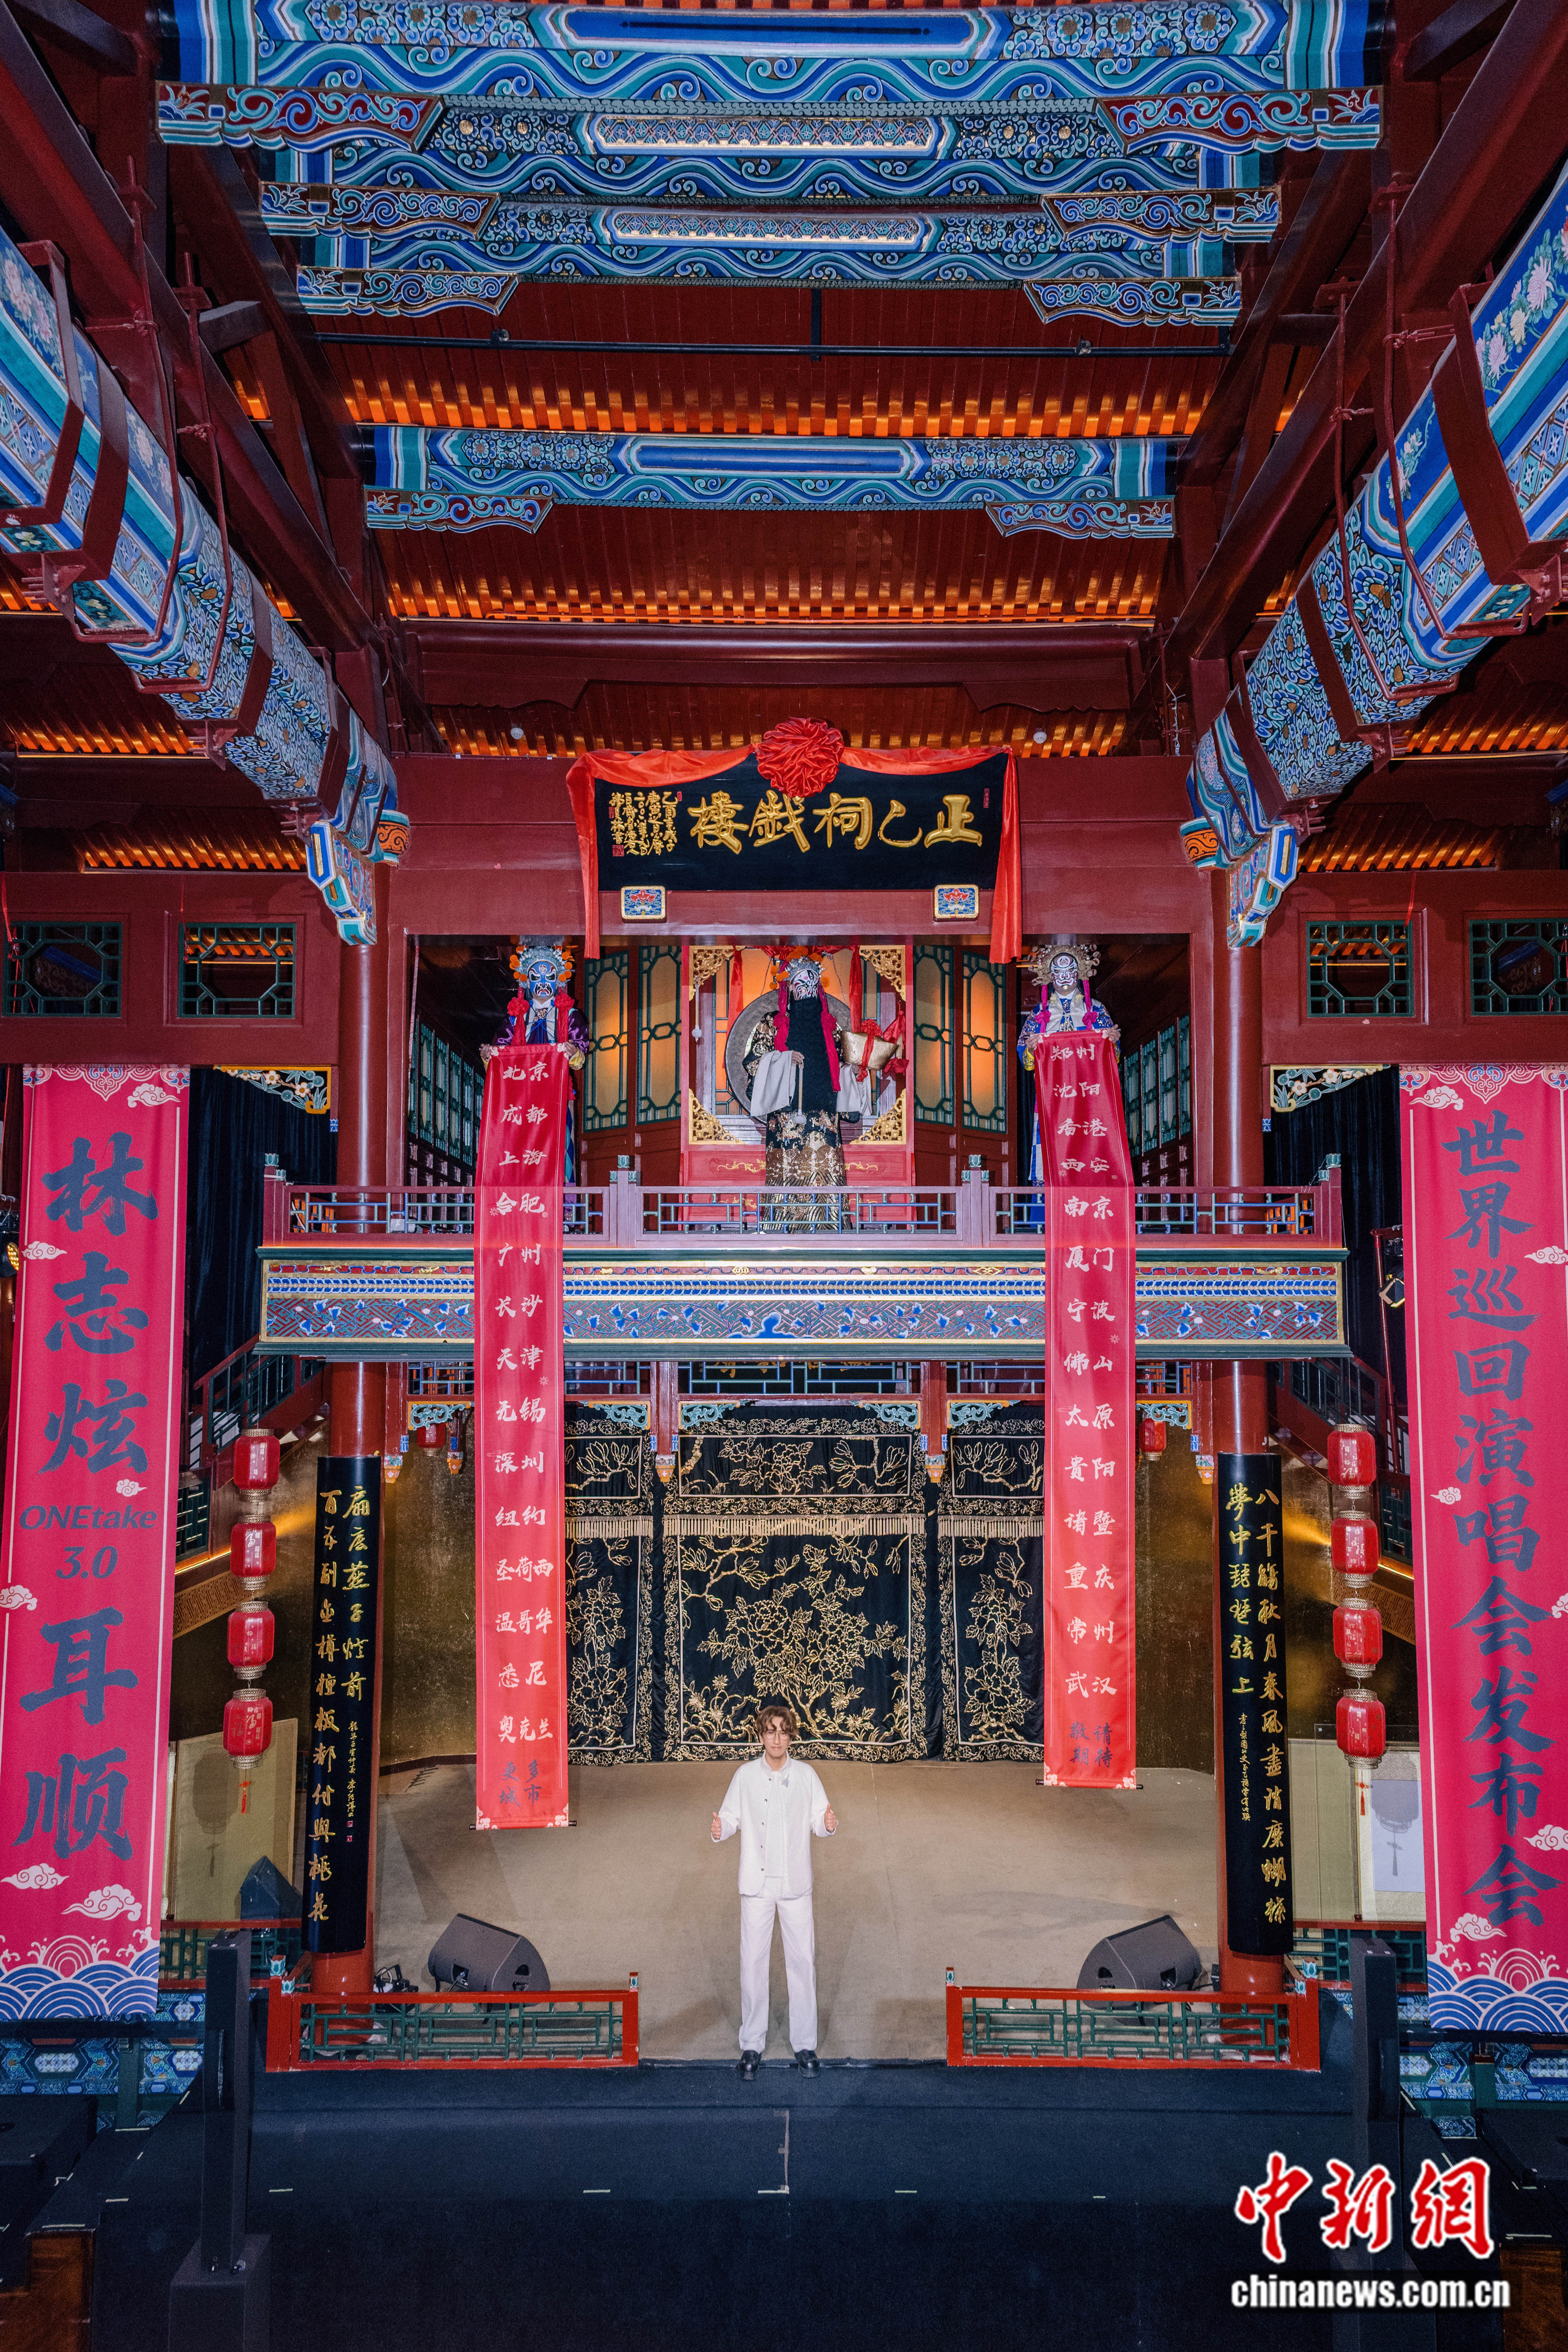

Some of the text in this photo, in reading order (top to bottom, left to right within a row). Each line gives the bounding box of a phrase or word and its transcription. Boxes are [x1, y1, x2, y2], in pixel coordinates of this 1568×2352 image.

[1050, 1043, 1095, 1061] 郑州
[503, 1061, 549, 1081] 北京
[1053, 1082, 1100, 1098] 沈阳
[500, 1104, 548, 1125] 成都
[1057, 1118, 1107, 1137] 香港
[499, 1149, 547, 1166] 上海
[1060, 1157, 1110, 1173] 西安
[496, 1192, 545, 1216] 合肥
[1064, 1195, 1114, 1219] 南京
[498, 1242, 541, 1266] 广州
[1065, 1245, 1114, 1272] 厦门
[38, 1131, 158, 1474] 林志炫
[495, 1294, 543, 1318] 长沙
[1067, 1298, 1116, 1322] 宁波
[496, 1345, 544, 1371] 天津
[1063, 1350, 1113, 1375] 佛山
[496, 1397, 546, 1423] 无锡
[1065, 1403, 1115, 1429] 太原
[494, 1451, 544, 1473] 深圳
[1064, 1455, 1115, 1482] 贵阳
[20, 1504, 157, 1529] ONEtake
[495, 1505, 546, 1527] 纽约
[1063, 1509, 1115, 1536] 诸暨
[1441, 1109, 1564, 1927] 世界巡回演唱会发布会
[56, 1546, 117, 1579] 3.0
[496, 1556, 554, 1582] 圣荷西
[1064, 1561, 1115, 1590] 重庆
[495, 1607, 553, 1634] 温哥华
[1067, 1617, 1114, 1645] 常州
[498, 1661, 547, 1688] 悉尼
[1065, 1670, 1117, 1698] 武汉
[12, 1606, 138, 1861] 耳顺
[498, 1715, 553, 1743] 奥克兰
[1069, 1721, 1113, 1746] 敬请
[1069, 1746, 1113, 1768] 期待
[498, 1759, 540, 1783] 更多
[498, 1783, 542, 1807] 城市
